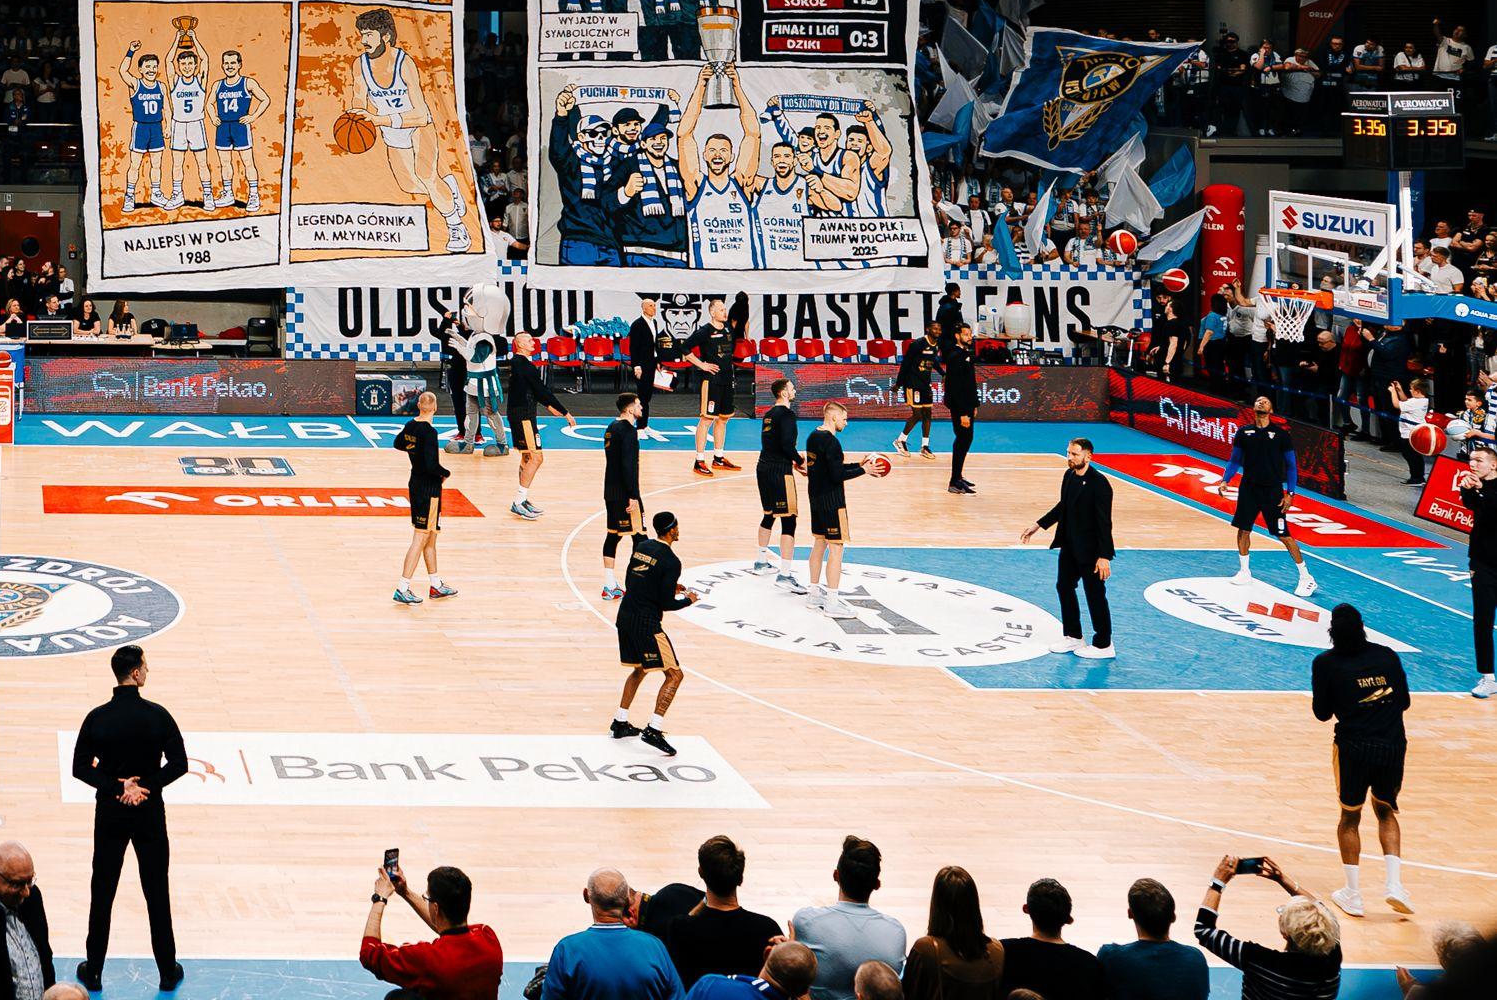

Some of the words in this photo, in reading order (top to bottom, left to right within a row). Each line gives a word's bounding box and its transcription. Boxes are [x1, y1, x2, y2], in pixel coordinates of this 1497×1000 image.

[558, 16, 605, 25] WYJAZDY
[545, 29, 630, 38] SYMBOLICZNYCH
[772, 25, 806, 35] FINAŁ
[809, 25, 812, 35] I
[816, 25, 839, 35] LIGI
[850, 30, 879, 47] 0:3
[564, 41, 614, 49] LICZBACH
[787, 39, 820, 49] DZIKI
[580, 87, 618, 98] PUCHAR
[630, 88, 665, 99] POLSKI
[143, 101, 157, 114] 10
[184, 100, 193, 113] 5
[223, 99, 239, 112] 14
[385, 98, 403, 108] 12
[1352, 99, 1387, 109] AEROWATCH
[1394, 98, 1450, 108] AEROWATCH
[729, 203, 742, 213] 55
[298, 213, 355, 227] LEGENDA
[357, 212, 416, 226] GÓRNIKA
[704, 217, 745, 228] GÓRNIK
[764, 216, 802, 227] GÓRNIK
[1302, 211, 1374, 237] SUZUKI
[820, 223, 857, 232] AWANS
[859, 223, 877, 232] DO
[879, 221, 897, 231] PLK
[124, 234, 186, 253] NAJLEPSI
[188, 232, 204, 246] W
[207, 225, 260, 244] POLSCE
[314, 230, 329, 242] M.
[332, 229, 402, 244] MŁYNARSKI
[811, 234, 847, 244] TRIUMF
[848, 234, 860, 243] W
[861, 233, 918, 244] PUCHARZE
[178, 250, 211, 265] 1988
[852, 246, 878, 256] 2025
[976, 285, 1090, 343] FANS
[143, 376, 200, 398] Bank
[1190, 410, 1226, 442] Bank
[213, 494, 411, 508] ORLEN
[1429, 502, 1454, 520] Bank
[5, 558, 154, 596] ZDRÓJ
[1166, 587, 1284, 637] SUZUKI
[9, 614, 152, 654] AQUA
[917, 621, 1033, 658] CASTLE
[1357, 675, 1386, 688] TAYLOR
[270, 753, 468, 782] Bank
[479, 754, 717, 784] Pekao
